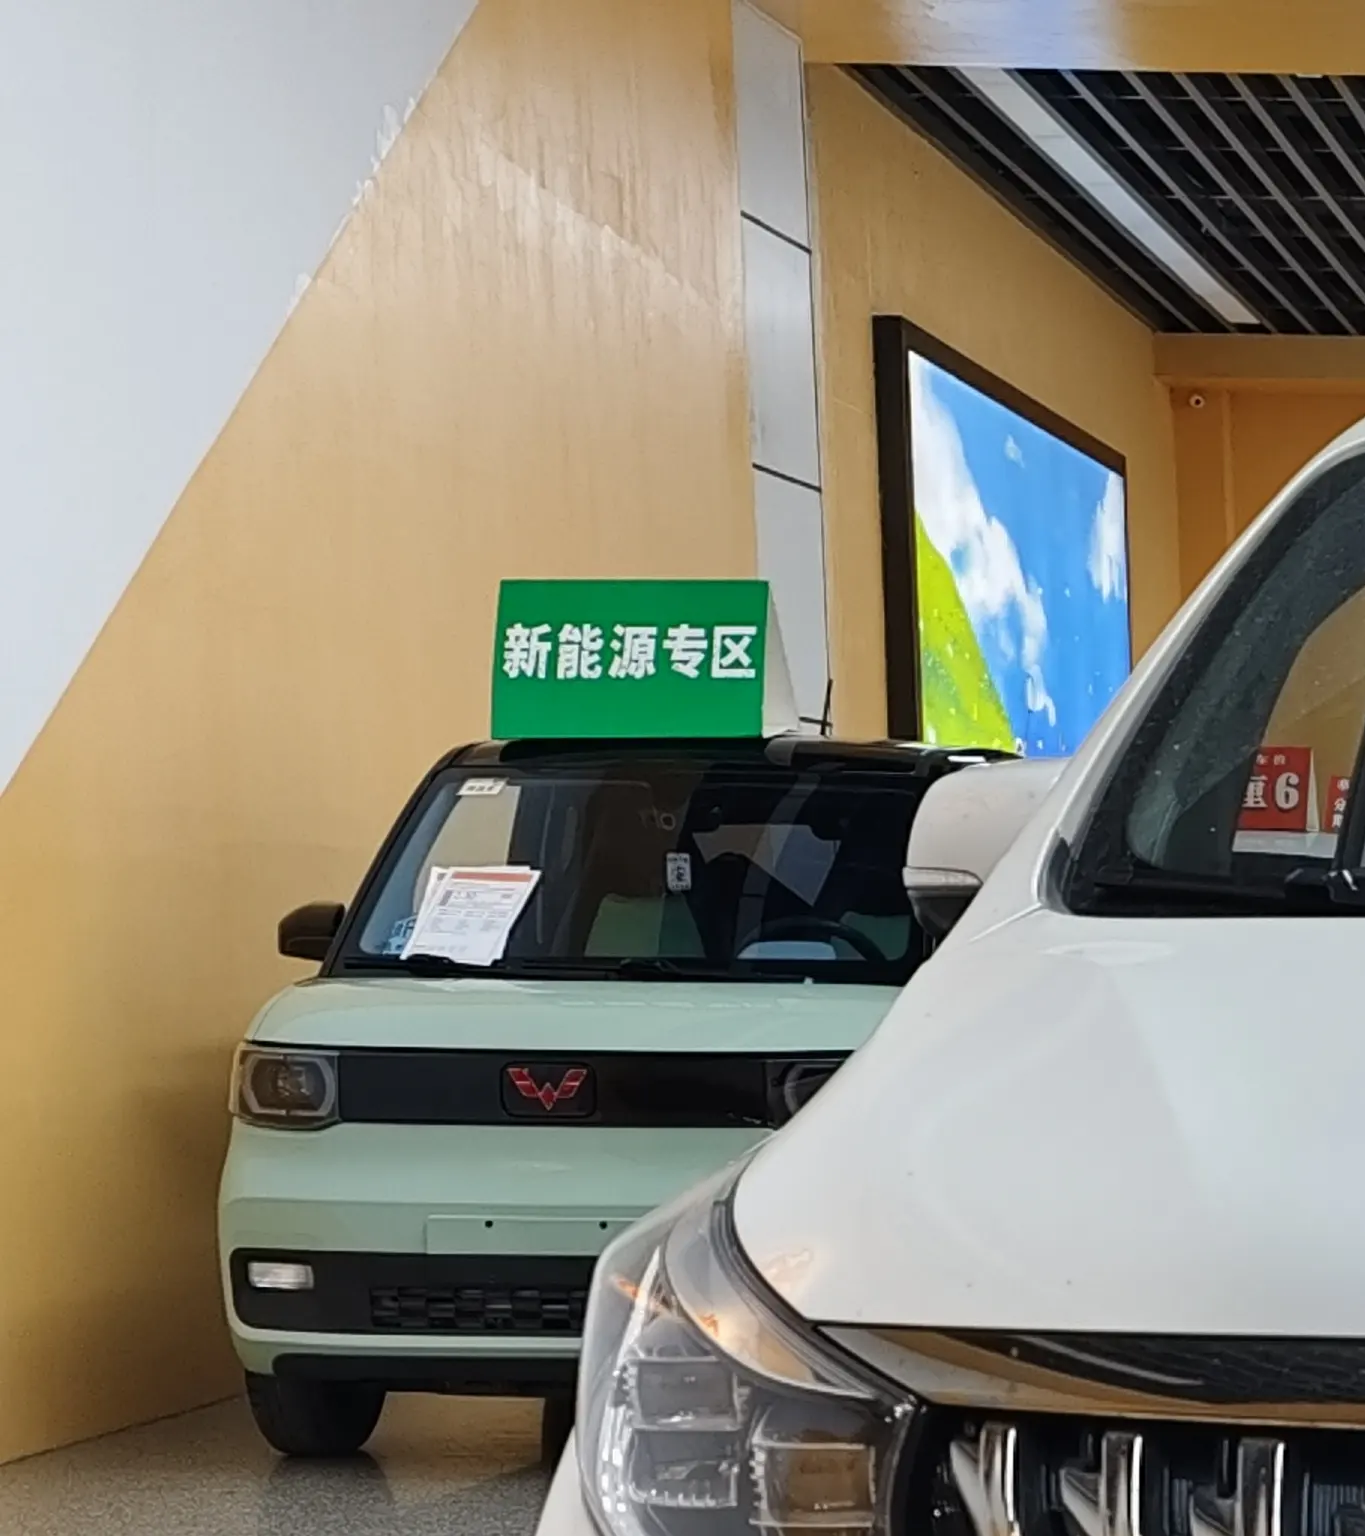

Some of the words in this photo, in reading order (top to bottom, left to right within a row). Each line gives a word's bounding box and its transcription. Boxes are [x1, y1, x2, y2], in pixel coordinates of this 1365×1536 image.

[503, 623, 757, 679] 新能源专区
